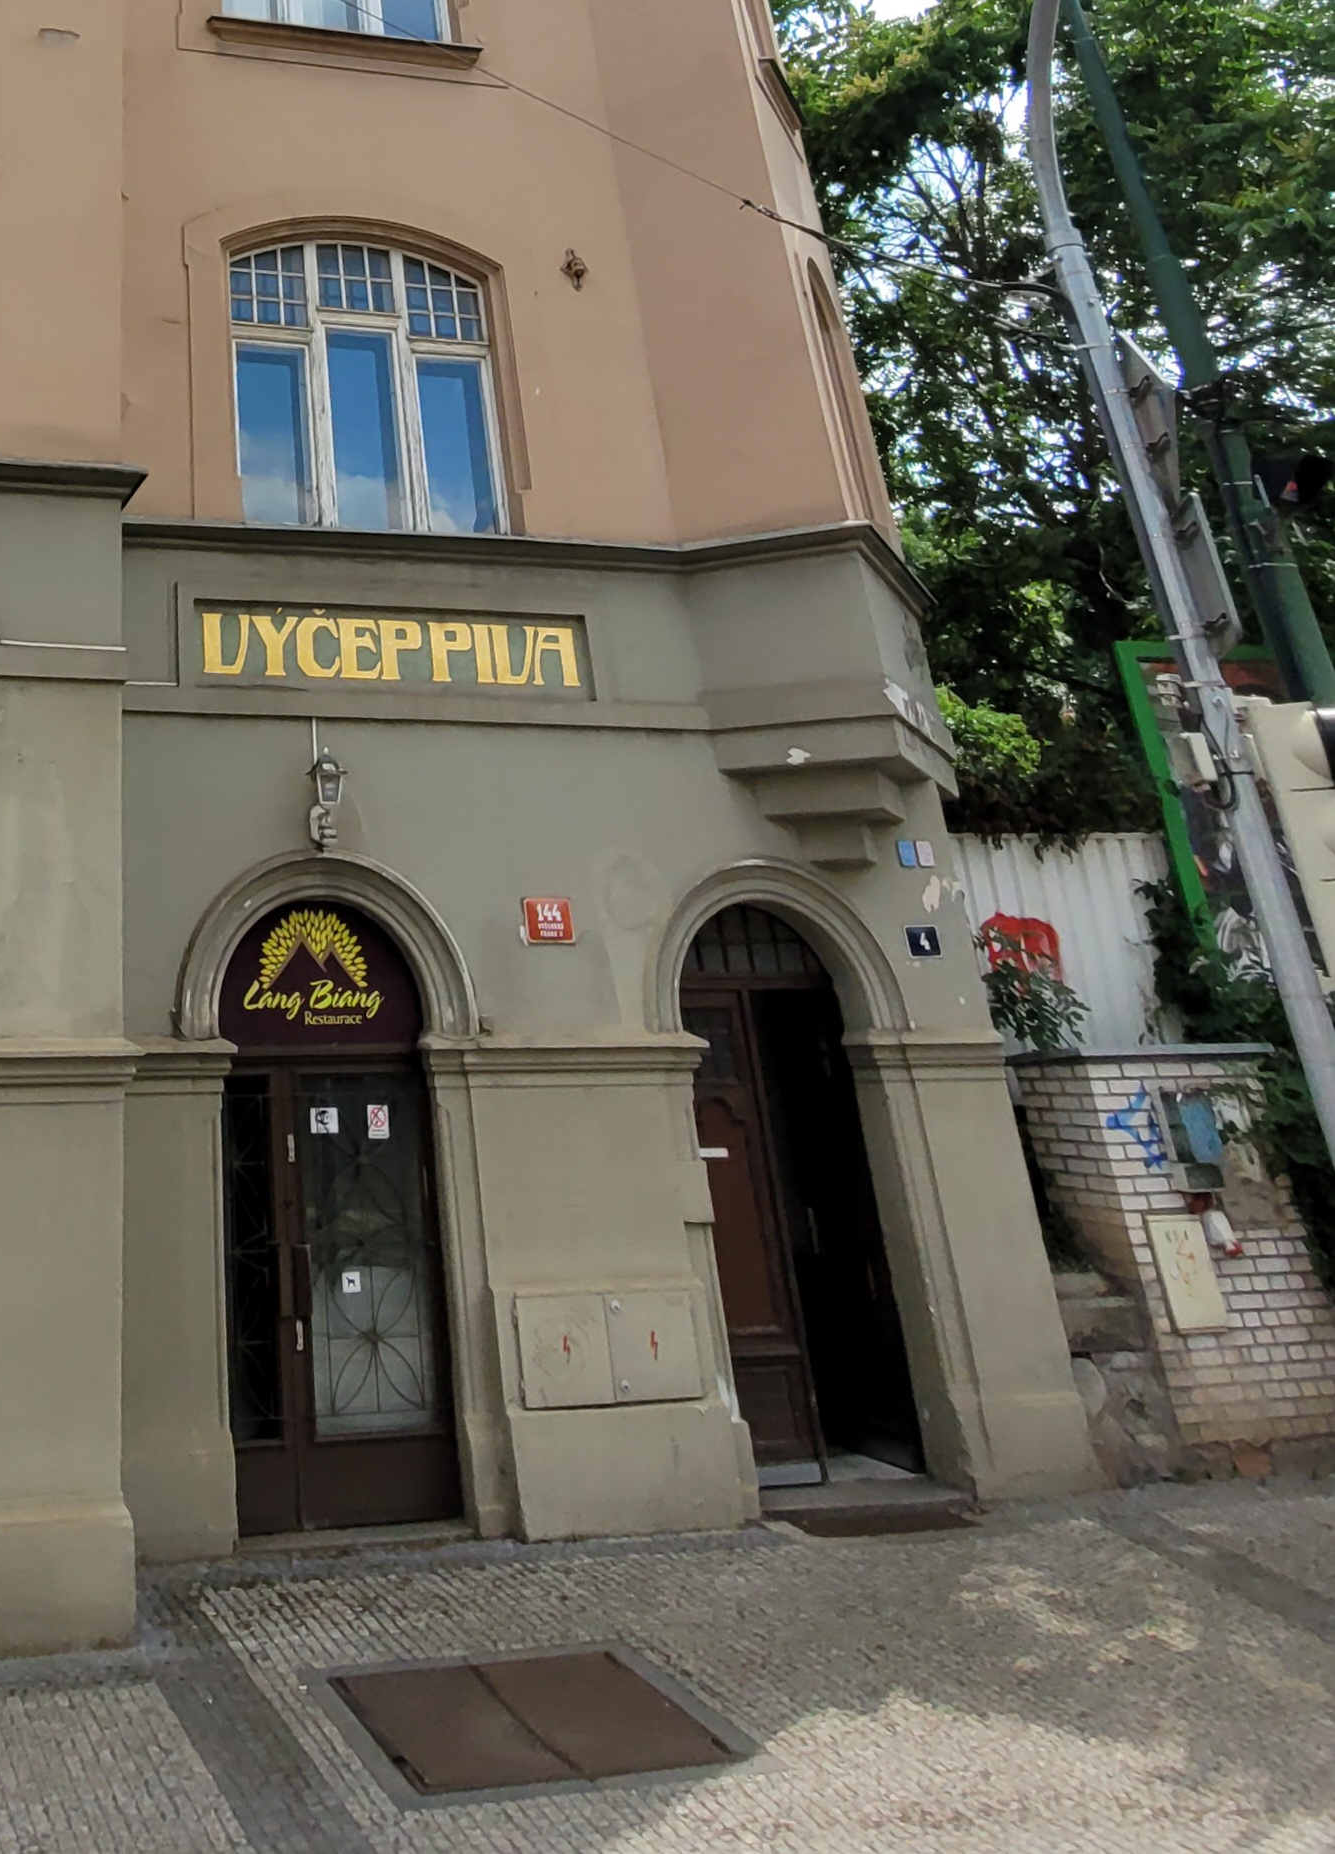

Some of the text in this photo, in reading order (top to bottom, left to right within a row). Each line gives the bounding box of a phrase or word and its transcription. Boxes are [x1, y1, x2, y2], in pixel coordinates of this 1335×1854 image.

[201, 607, 581, 687] VÝČEP PIVA
[536, 903, 562, 921] 144
[919, 932, 931, 951] 4
[242, 979, 384, 1021] Lang Biang
[304, 1010, 363, 1026] Restaurace
